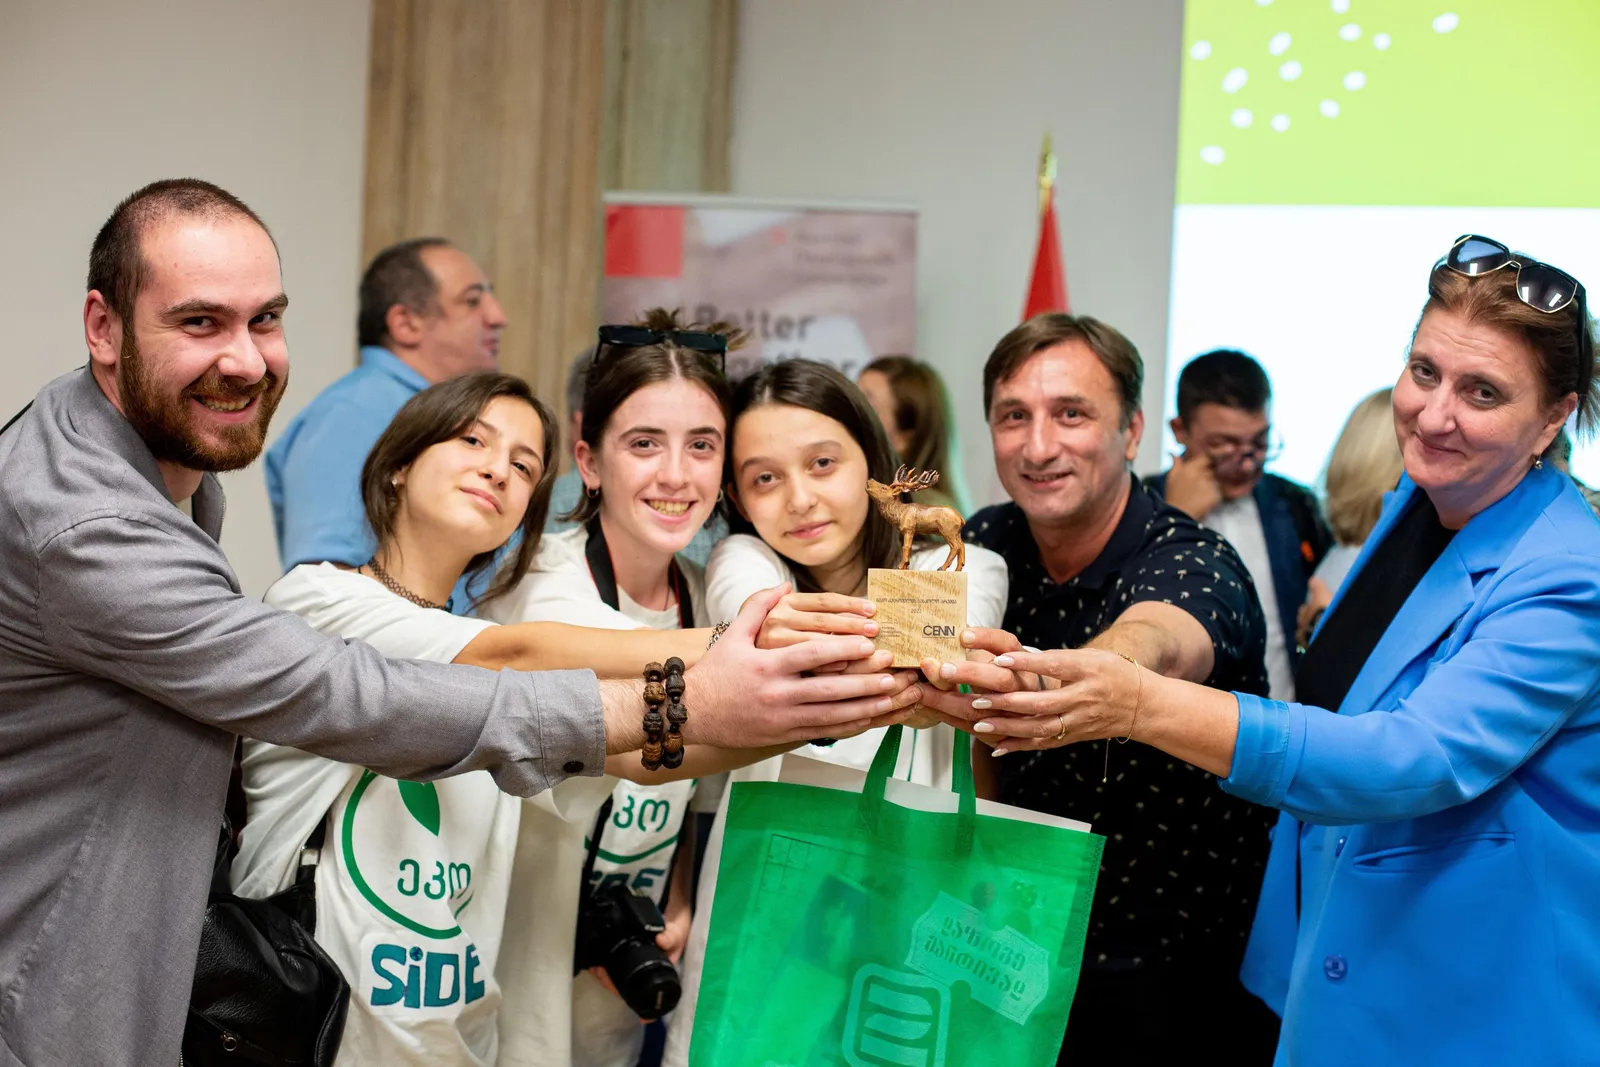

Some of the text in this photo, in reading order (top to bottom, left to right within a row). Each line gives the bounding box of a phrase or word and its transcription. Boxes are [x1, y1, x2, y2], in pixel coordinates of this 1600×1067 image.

[923, 625, 955, 636] CENN
[613, 794, 670, 832] კო
[397, 858, 471, 900] ეკო
